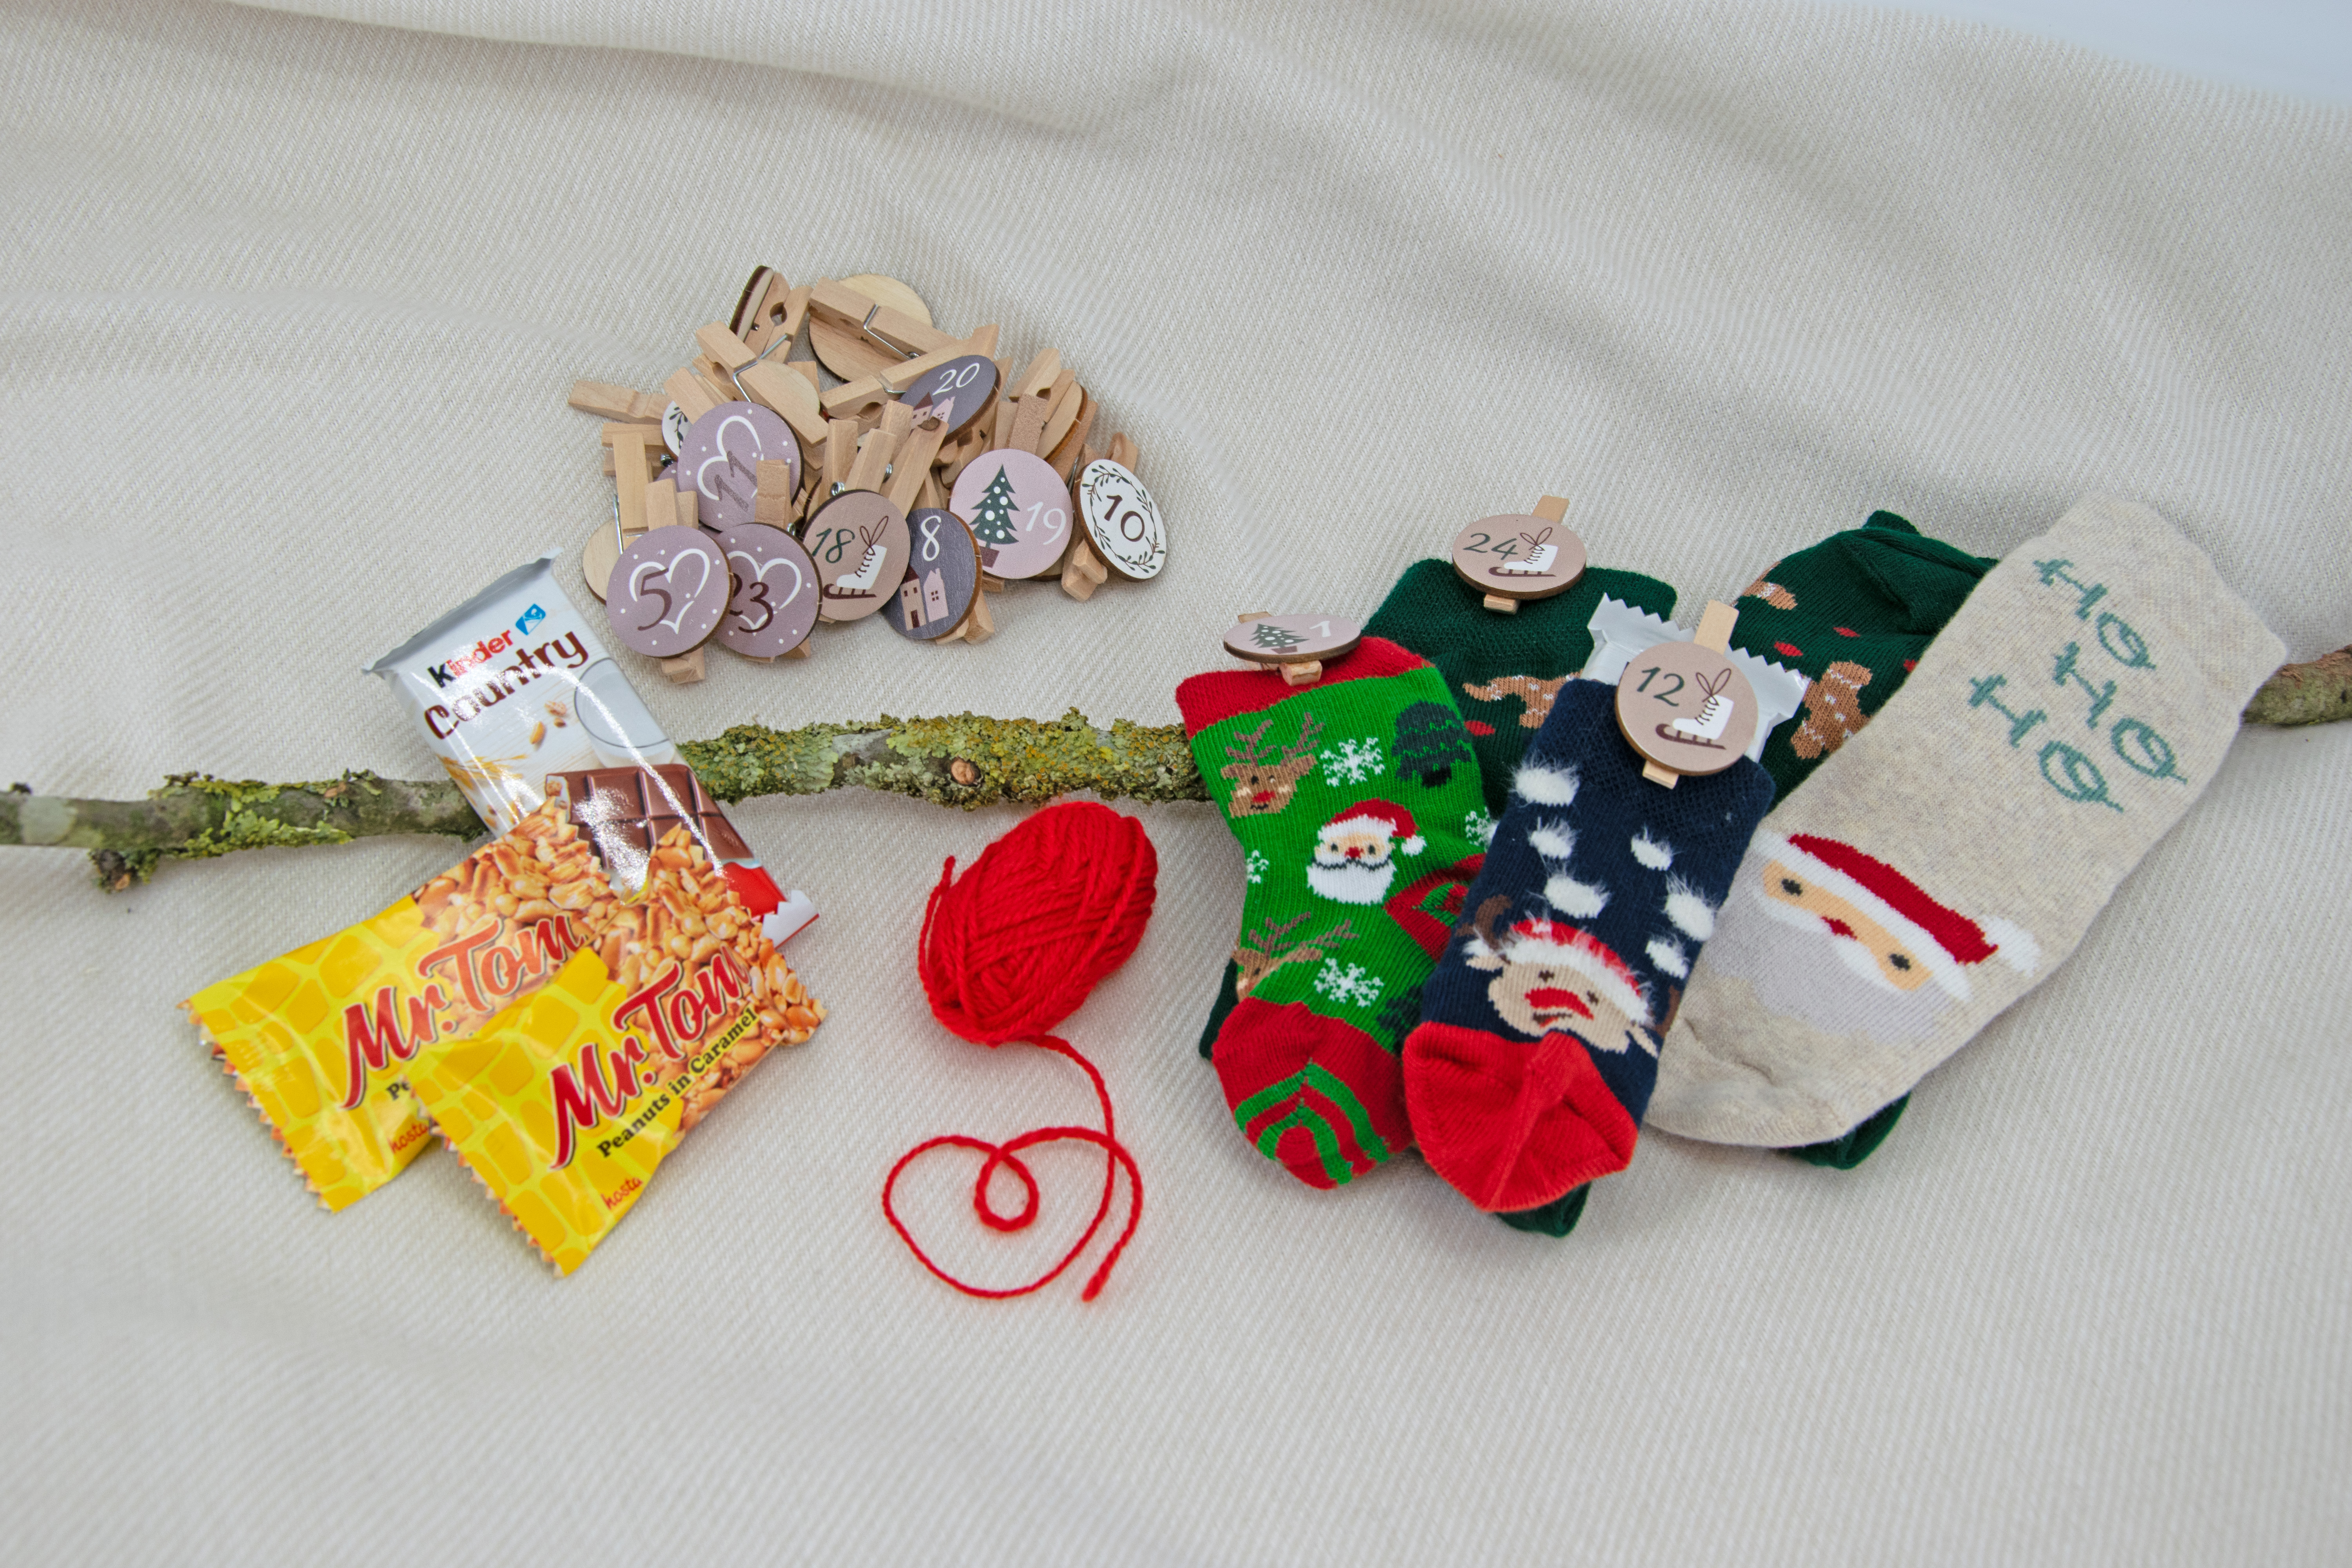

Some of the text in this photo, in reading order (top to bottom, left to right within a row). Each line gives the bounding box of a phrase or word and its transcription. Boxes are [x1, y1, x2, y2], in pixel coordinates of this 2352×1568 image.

[932, 363, 980, 396] 20
[920, 515, 941, 561] 8
[1025, 501, 1066, 545] 19
[1103, 495, 1145, 542] 10
[812, 528, 855, 564] 18
[1463, 532, 1519, 560] 24
[637, 568, 673, 631] 5
[2033, 559, 2157, 670] HO
[1310, 621, 1331, 638] 1
[424, 631, 589, 740] Country
[1636, 666, 1685, 707] 12
[2052, 641, 2188, 785] HO
[1967, 673, 2124, 813] HO
[339, 915, 586, 1109] Mr. Tom
[549, 945, 751, 1169] Mr. Tom
[597, 1007, 757, 1158] Peanuts in Caramel
[601, 1177, 643, 1210] hosta
